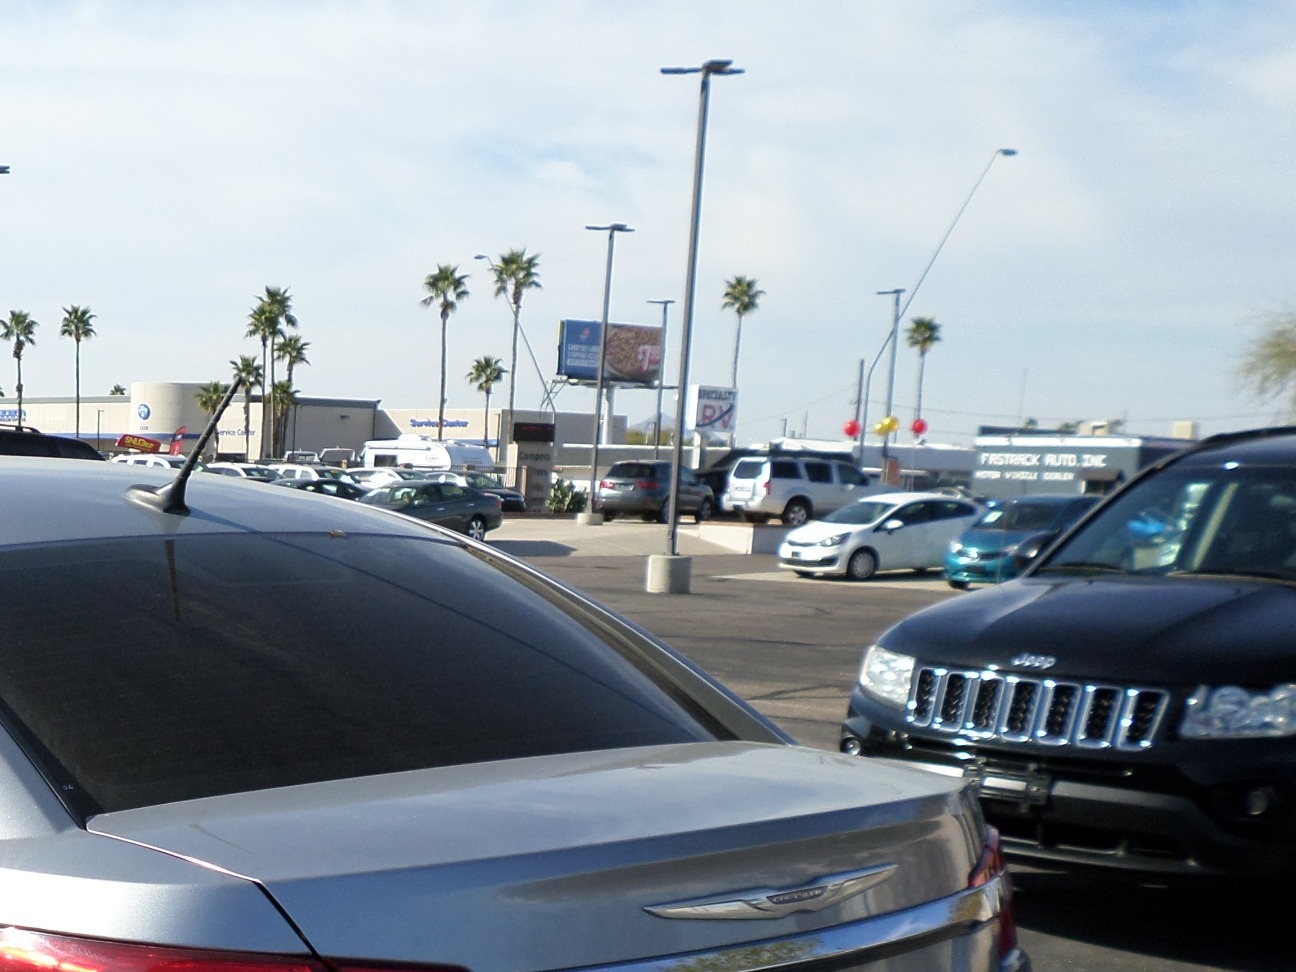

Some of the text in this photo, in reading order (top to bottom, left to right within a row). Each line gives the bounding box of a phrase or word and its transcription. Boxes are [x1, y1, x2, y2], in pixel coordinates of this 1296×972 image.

[410, 418, 440, 428] Service
[702, 404, 734, 429] RV
[980, 453, 1041, 466] FASTRACK
[1011, 653, 1056, 669] Jeep
